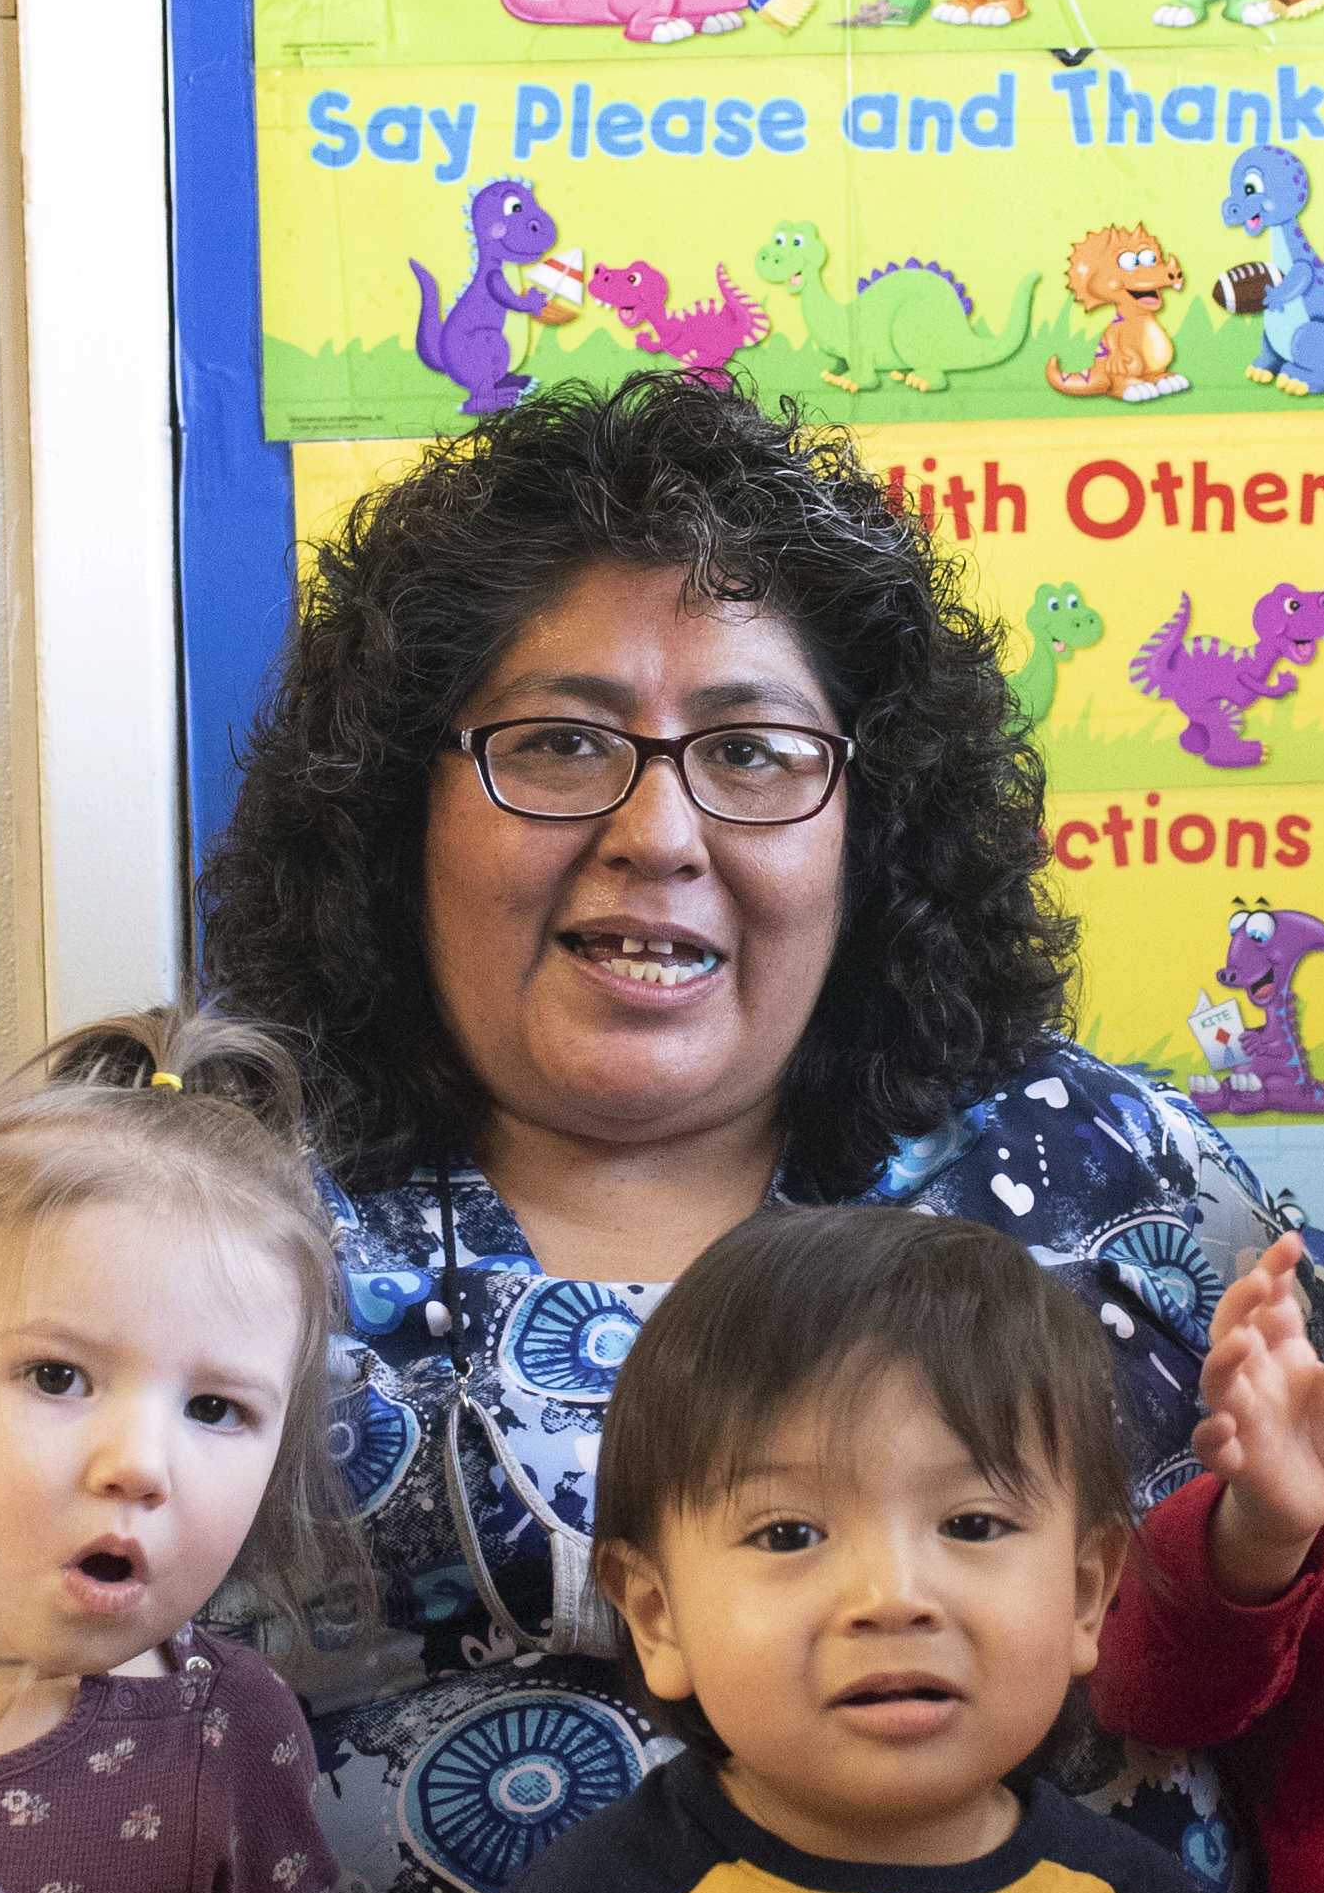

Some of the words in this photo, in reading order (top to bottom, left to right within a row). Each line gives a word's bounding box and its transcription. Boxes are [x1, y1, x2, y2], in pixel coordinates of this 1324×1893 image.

[309, 90, 476, 181] Say
[513, 84, 808, 160] Please
[841, 71, 1017, 152] and
[881, 458, 1026, 540] ith
[1037, 792, 1312, 871] ctions
[1200, 1010, 1232, 1028] KITE
